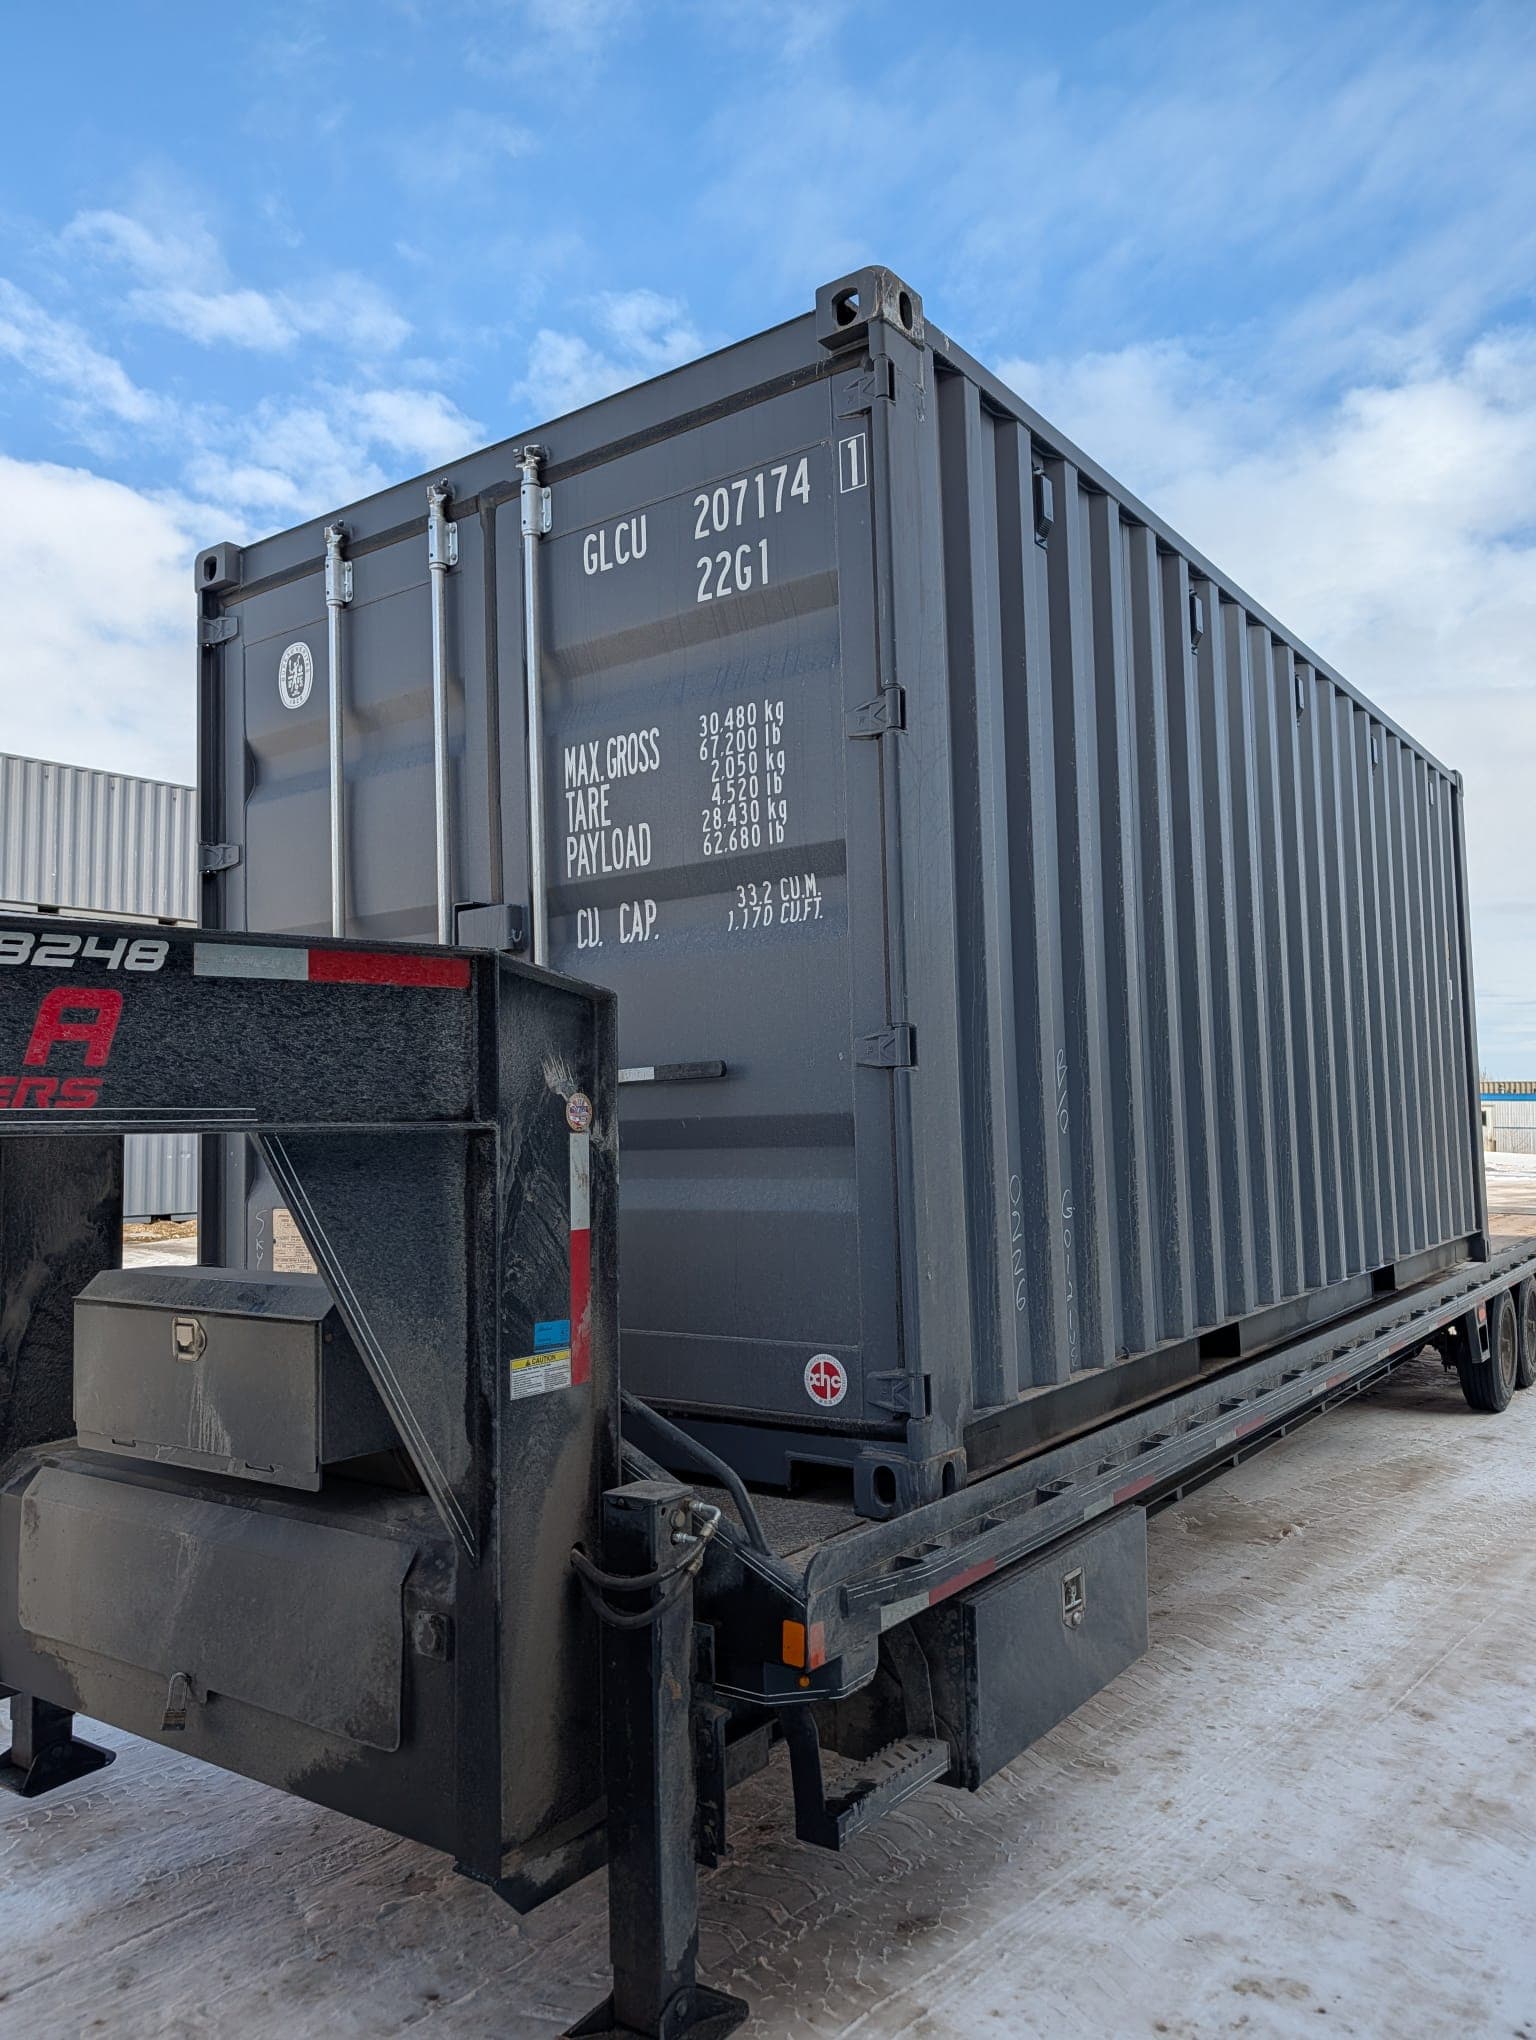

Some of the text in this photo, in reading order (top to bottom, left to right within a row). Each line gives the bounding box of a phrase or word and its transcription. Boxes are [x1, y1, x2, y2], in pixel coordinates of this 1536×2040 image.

[583, 439, 858, 575] GLCU 207174 1
[696, 538, 768, 602] 22G1
[699, 699, 784, 737] 30,480 kg
[565, 727, 660, 789] MAX. GROSS
[699, 722, 781, 761] 67,200 lb
[711, 748, 785, 783] 2,050 kg
[711, 771, 782, 806] 4,520 lb
[566, 783, 611, 833] TARE
[702, 797, 787, 833] 28,430 kg
[566, 822, 651, 878] PAYLOAD
[703, 820, 785, 856] 62,680 lb
[736, 880, 773, 908] 33.2
[577, 899, 660, 949] CU. CAP.
[727, 904, 773, 932] 1,170
